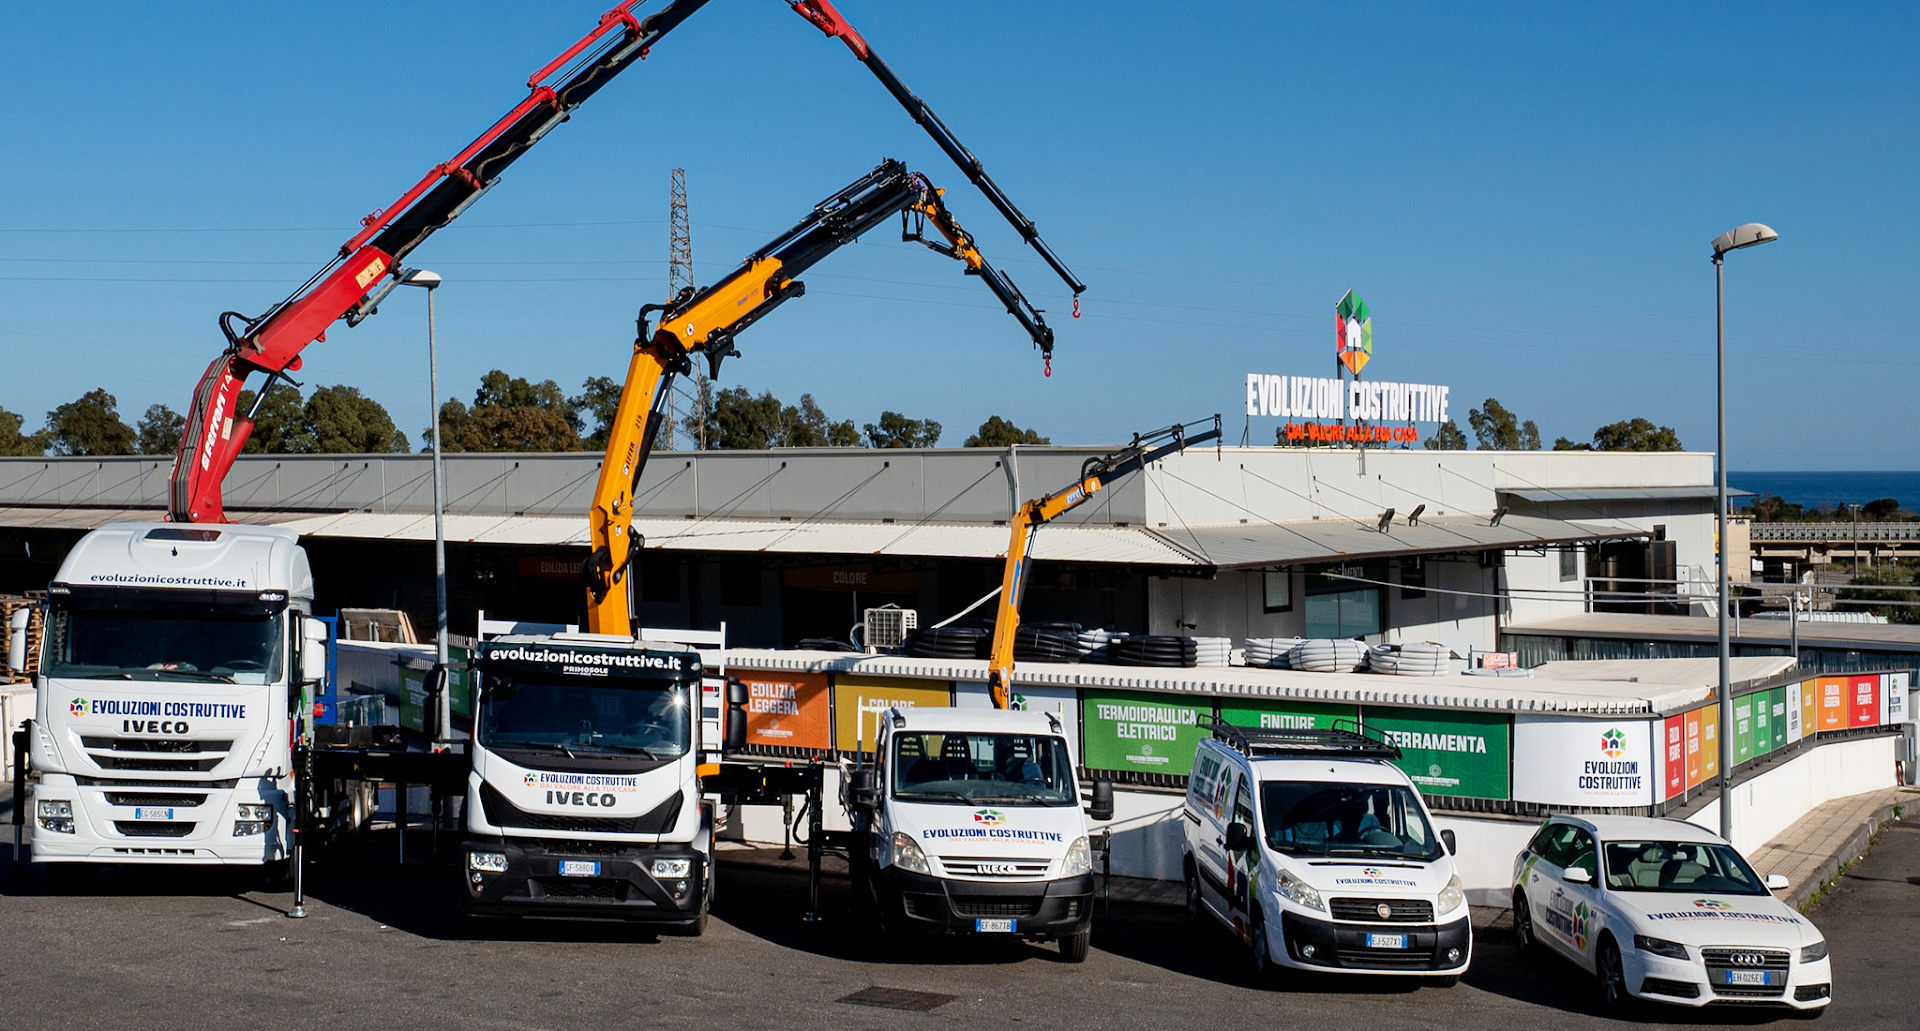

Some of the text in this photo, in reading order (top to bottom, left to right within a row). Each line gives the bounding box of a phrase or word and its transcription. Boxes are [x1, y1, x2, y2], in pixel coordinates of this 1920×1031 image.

[1247, 373, 1449, 423] EVOLUZIONI COSTRUTTIVE
[1286, 423, 1418, 442] DAI VALORE ALLA TUA CASA
[90, 573, 247, 588] evoluzionicostruttive.it
[833, 571, 867, 585] COLORE
[489, 646, 682, 671] evoluzionicostruttive.it
[563, 665, 609, 674] PRIMOSOLE
[751, 682, 796, 699] EDILIZIA
[92, 699, 246, 719] EVOLUZIONI COSTRUTTIVE
[749, 698, 799, 716] LEGGERA
[1097, 704, 1197, 725] TERMOIDRAULICA
[123, 719, 189, 735] IVECO
[1117, 722, 1176, 741] ELETTRICO
[1384, 730, 1487, 754] FERRAMENTA
[1585, 761, 1638, 774] EVOLUZIONI
[540, 773, 637, 787] EVOLUZIONI COSTRUTTIVE
[1578, 776, 1641, 790] COSTRUTTIVE
[546, 790, 616, 807] IVECO
[923, 829, 1063, 842] EVOLUZIONI COSTRUTTIVE
[977, 864, 1017, 874] IVECO
[1647, 911, 1804, 926] EVOLUZIONI COSTRUTTIVE
